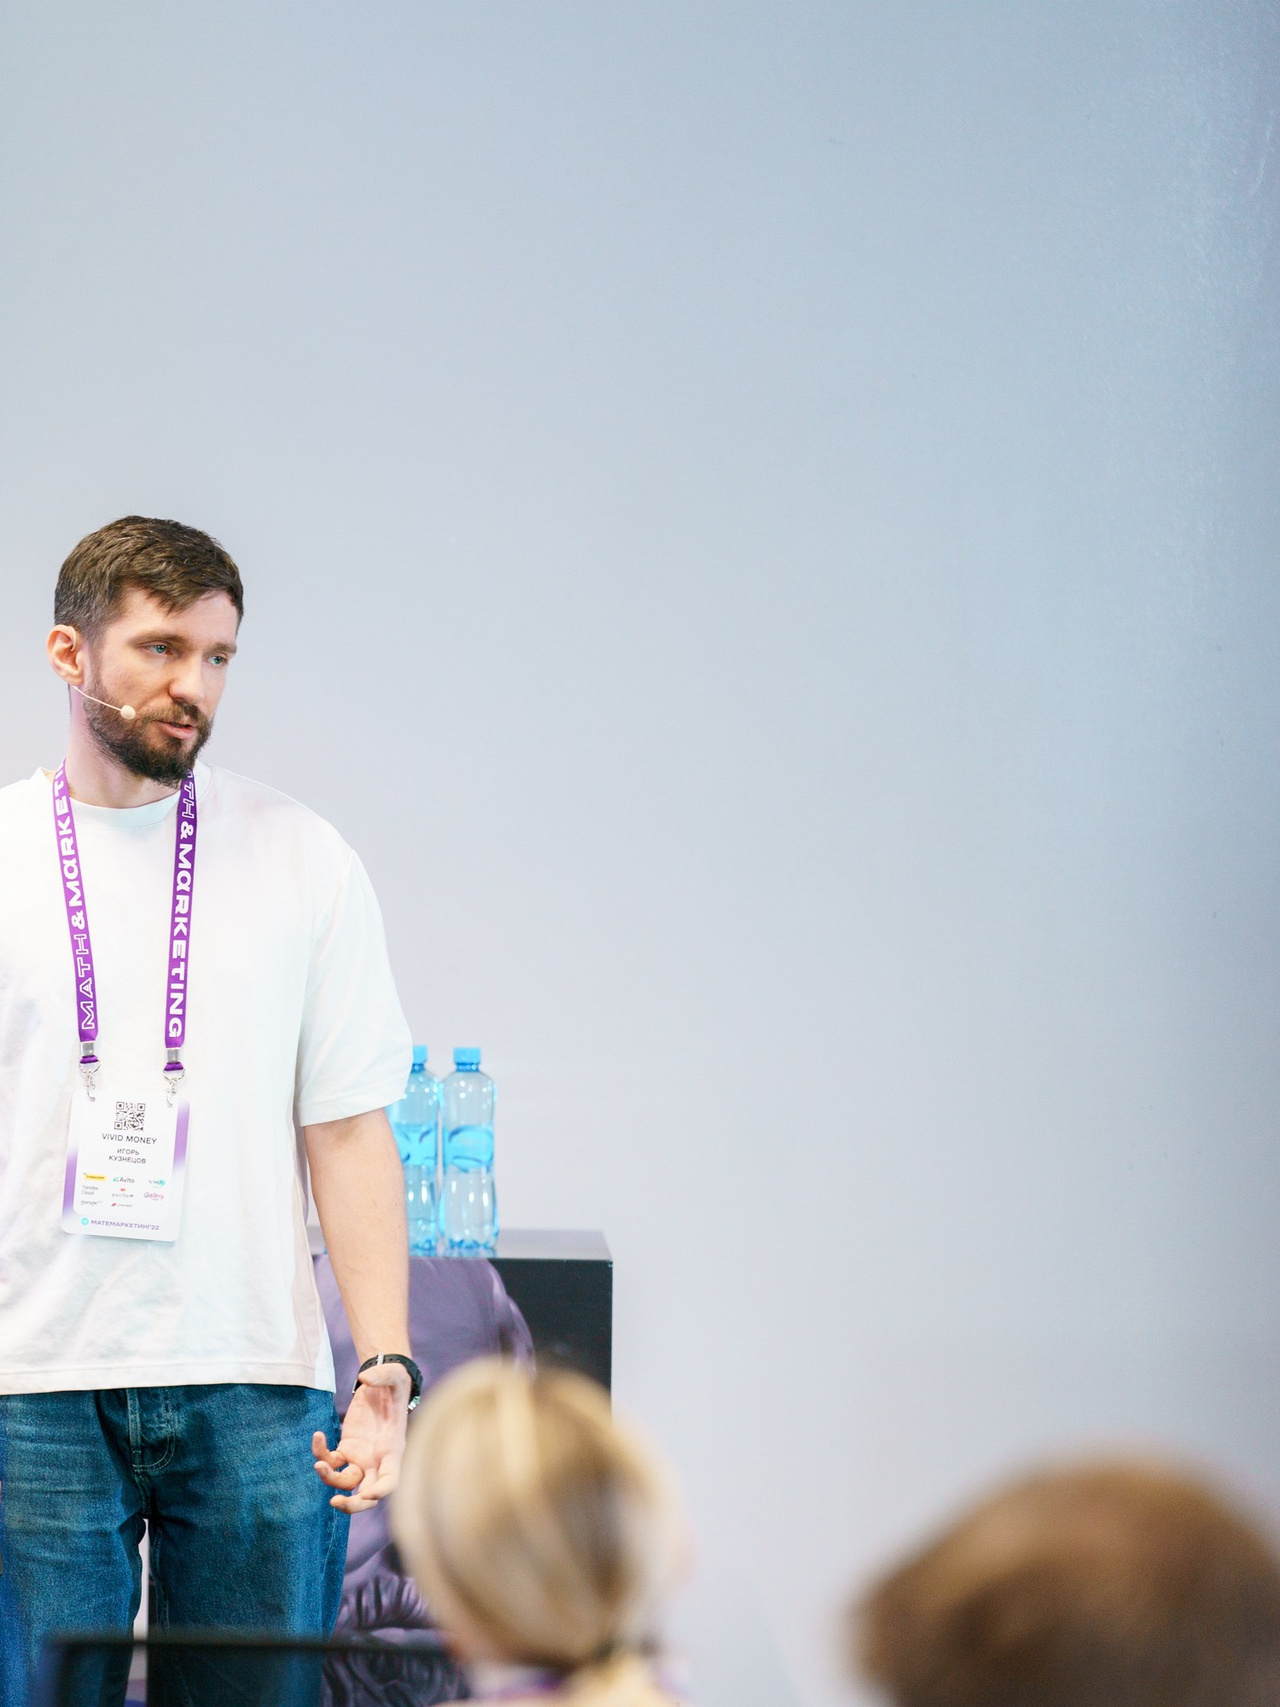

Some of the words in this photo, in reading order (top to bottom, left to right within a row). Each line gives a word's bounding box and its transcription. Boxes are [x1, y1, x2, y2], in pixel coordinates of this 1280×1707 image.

[101, 1133, 123, 1142] VIVID
[125, 1135, 157, 1145] MONEY
[116, 1148, 140, 1156] ИГОРЬ
[108, 1155, 147, 1165] КУЗНЕЦОВ
[90, 1219, 160, 1231] МАТЕМАРКЕТИНГ22
